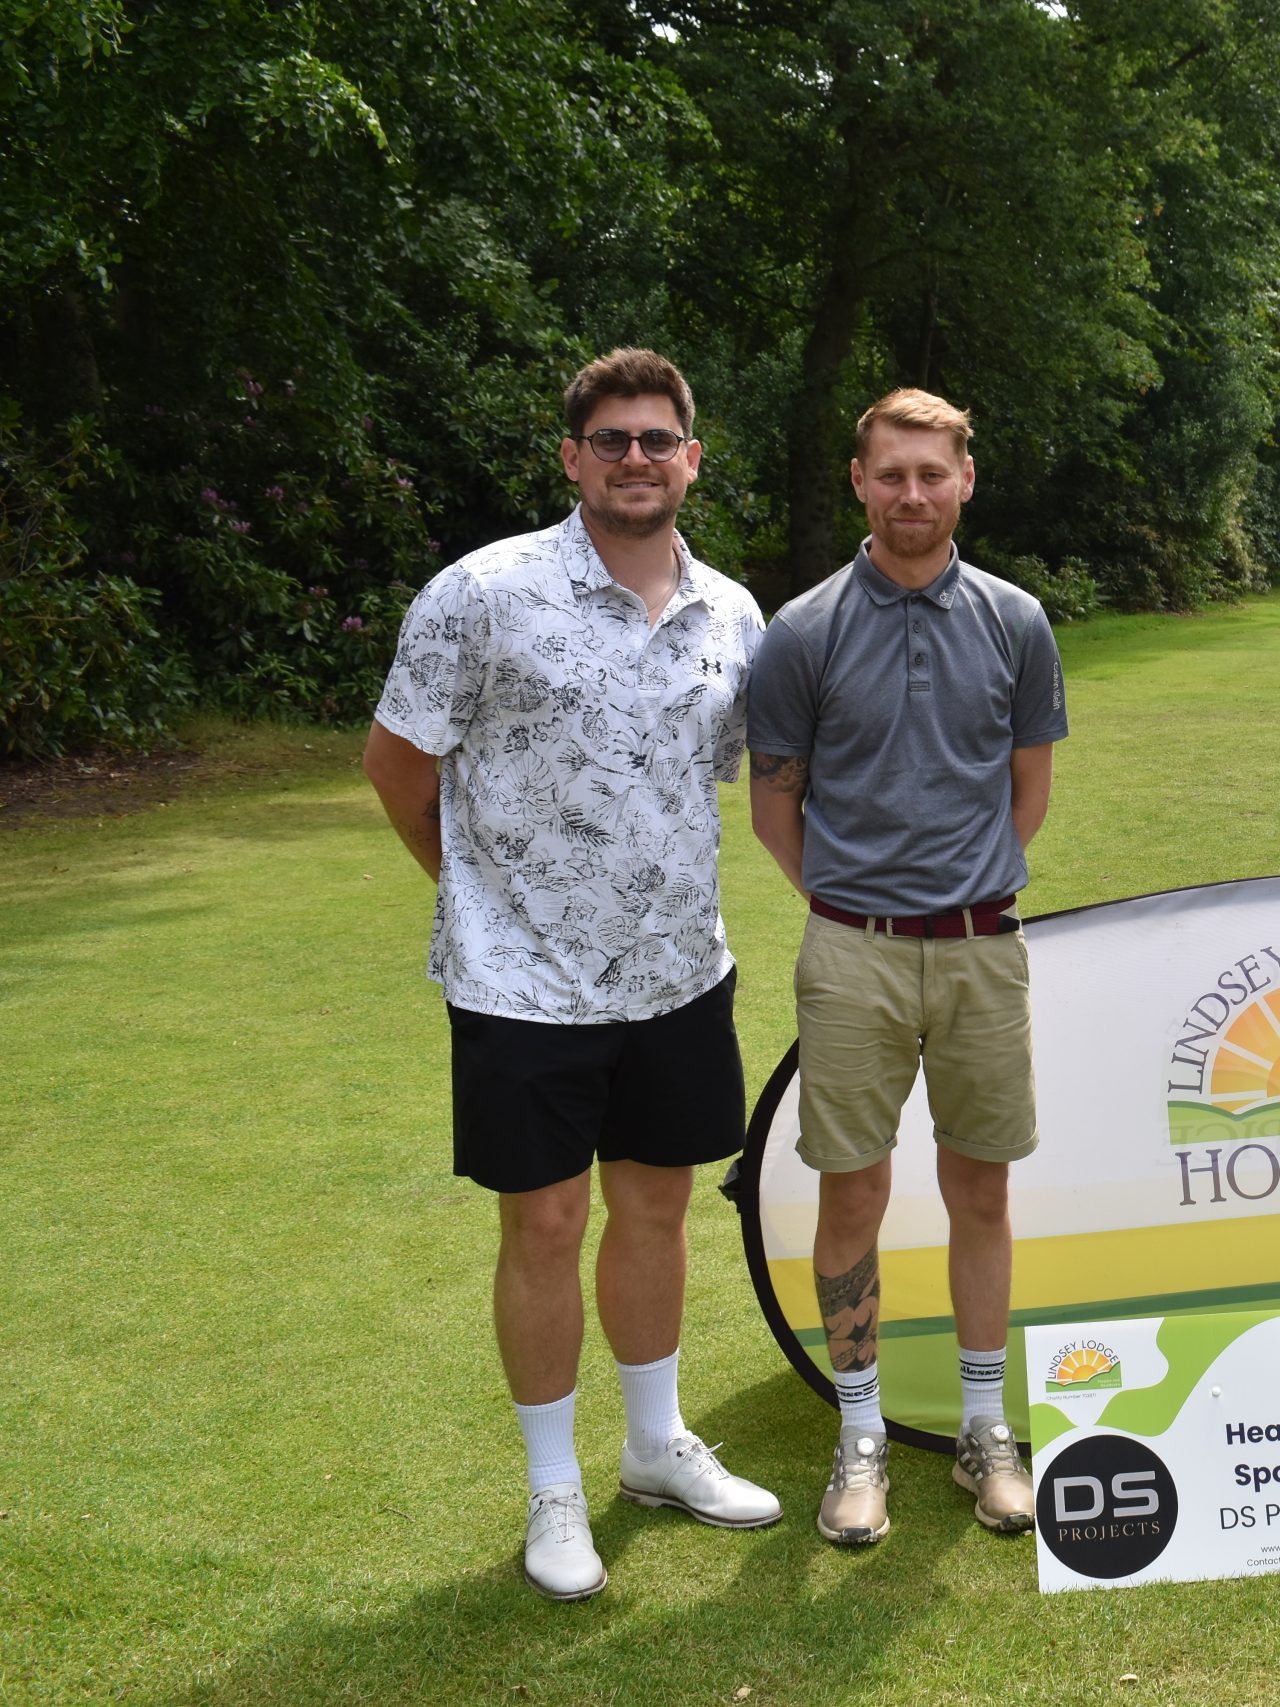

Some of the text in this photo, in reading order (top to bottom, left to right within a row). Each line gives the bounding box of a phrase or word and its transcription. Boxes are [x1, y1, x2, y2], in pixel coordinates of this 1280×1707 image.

[1047, 1339, 1119, 1380] LINDSEY LODGE
[1053, 1470, 1160, 1522] DS
[1059, 1521, 1160, 1542] PROJECTS
[1219, 1505, 1256, 1530] DS
